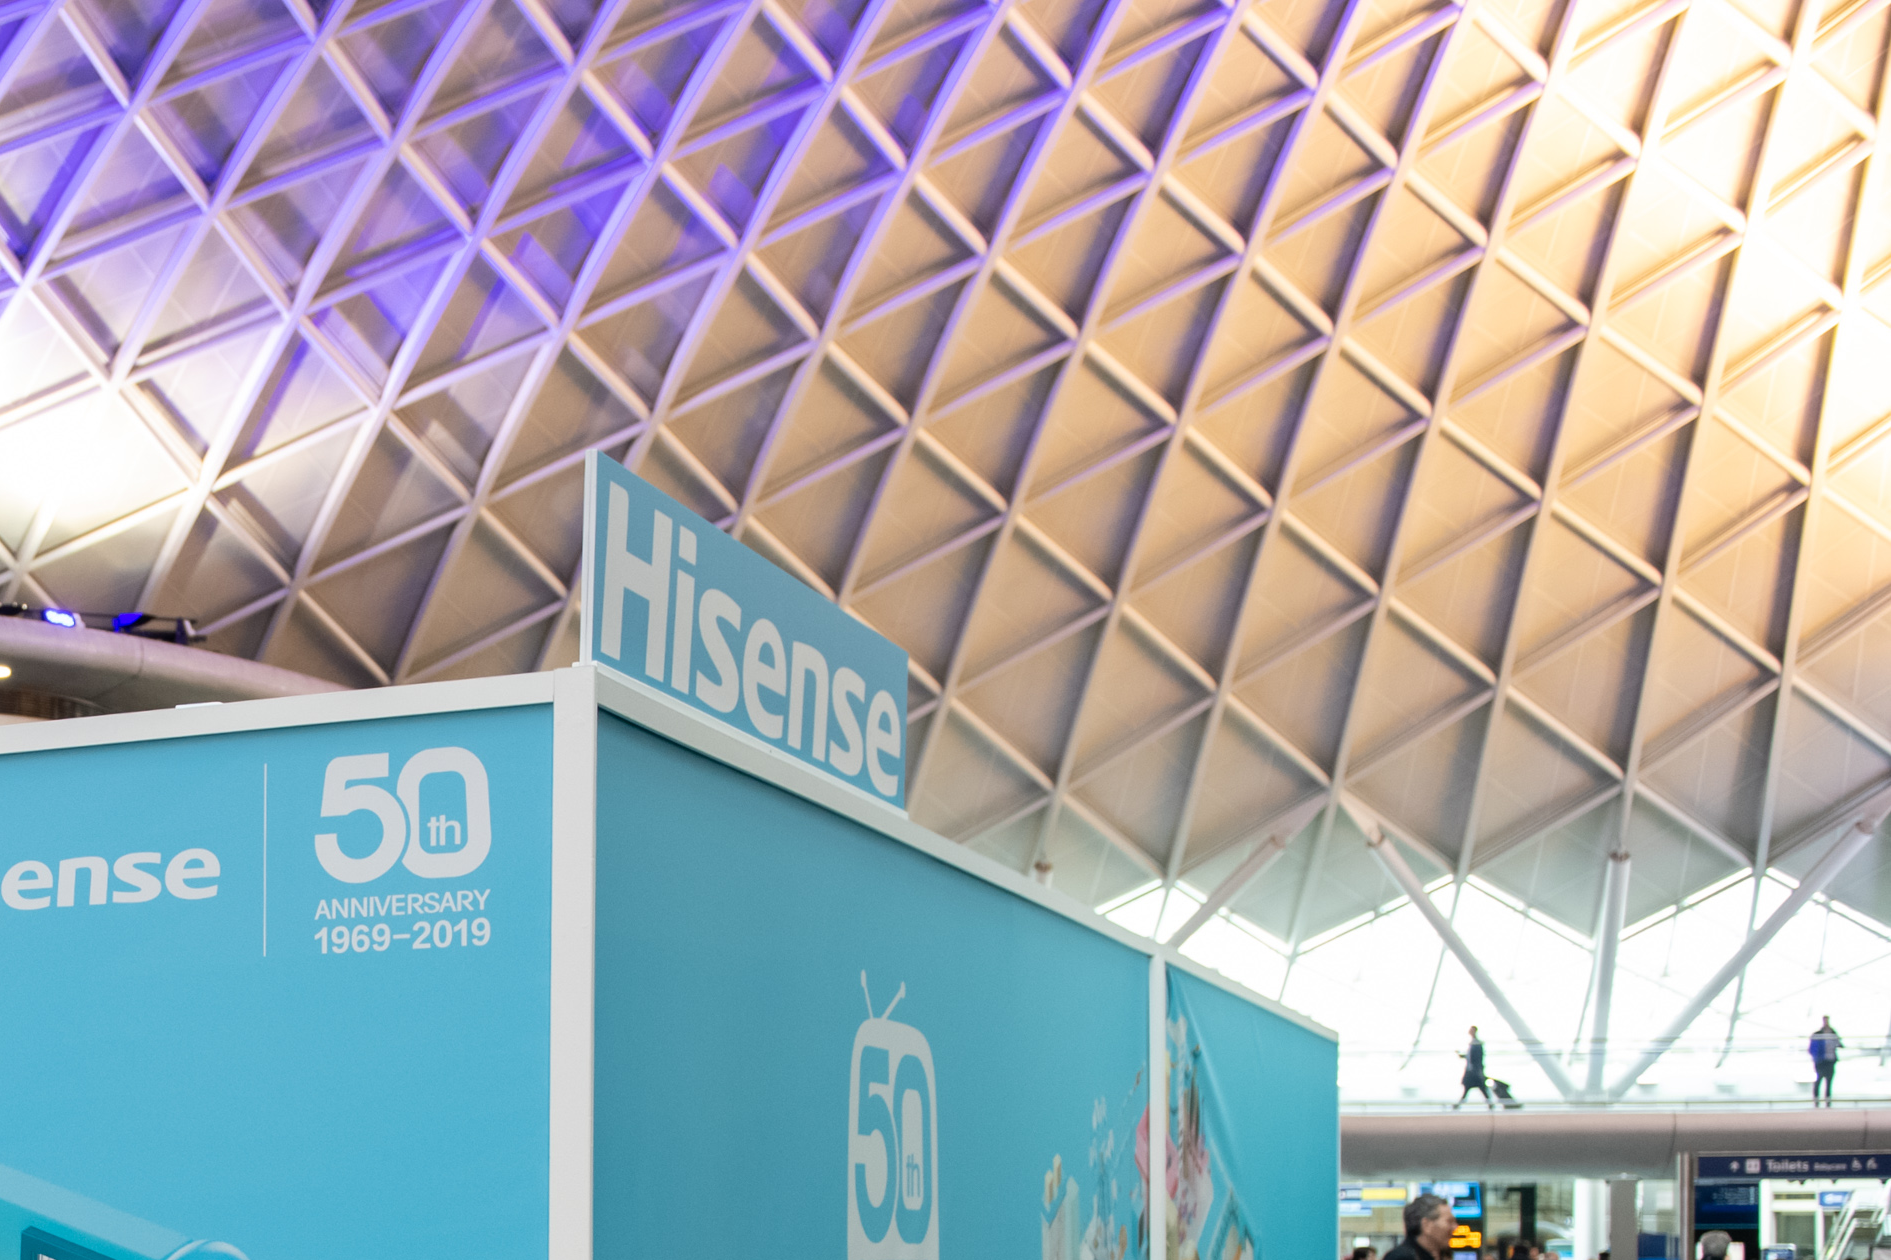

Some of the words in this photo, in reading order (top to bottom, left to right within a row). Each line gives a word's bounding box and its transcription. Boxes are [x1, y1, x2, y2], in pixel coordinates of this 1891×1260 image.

[601, 481, 902, 797] Hisense
[314, 888, 491, 921] ANNIVERSARY
[314, 917, 491, 955] 1969-2019
[1765, 1158, 1810, 1173] Toilets
